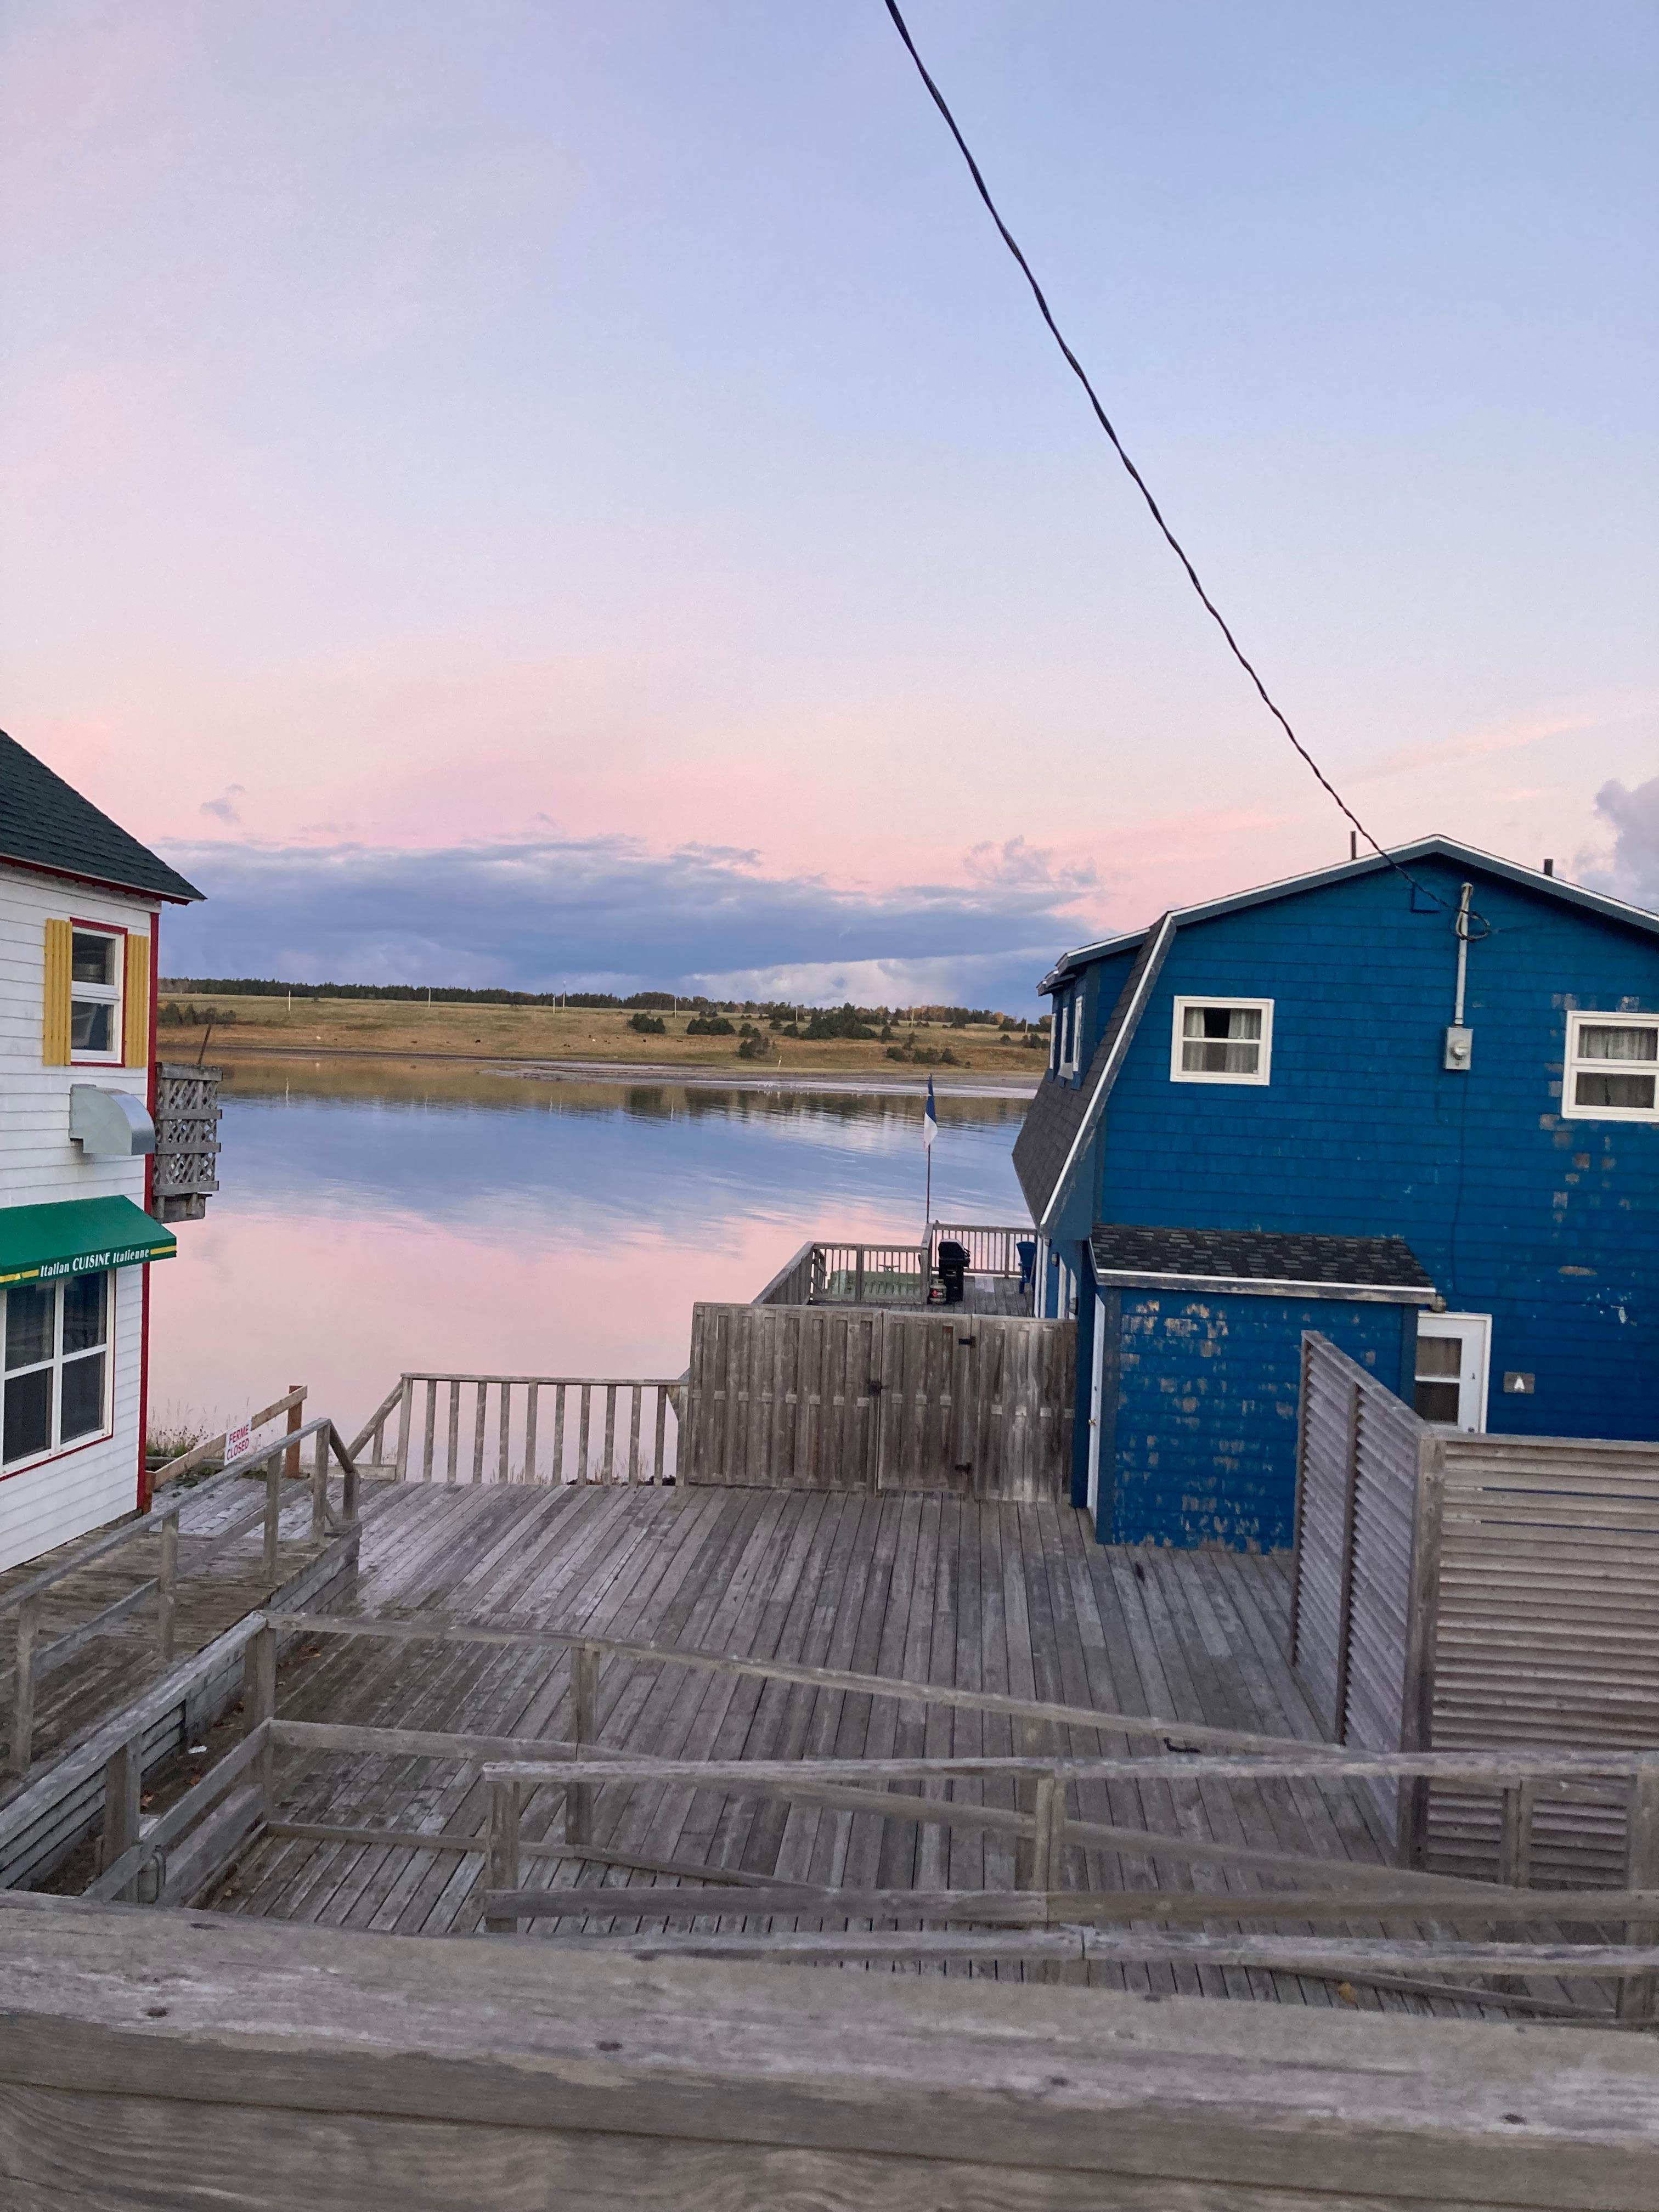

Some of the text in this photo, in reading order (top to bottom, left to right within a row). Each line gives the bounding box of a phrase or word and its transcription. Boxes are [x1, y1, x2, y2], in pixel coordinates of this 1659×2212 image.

[40, 1249, 149, 1277] Italian CUISINE Italienne
[227, 1438, 249, 1460] CLOSED
